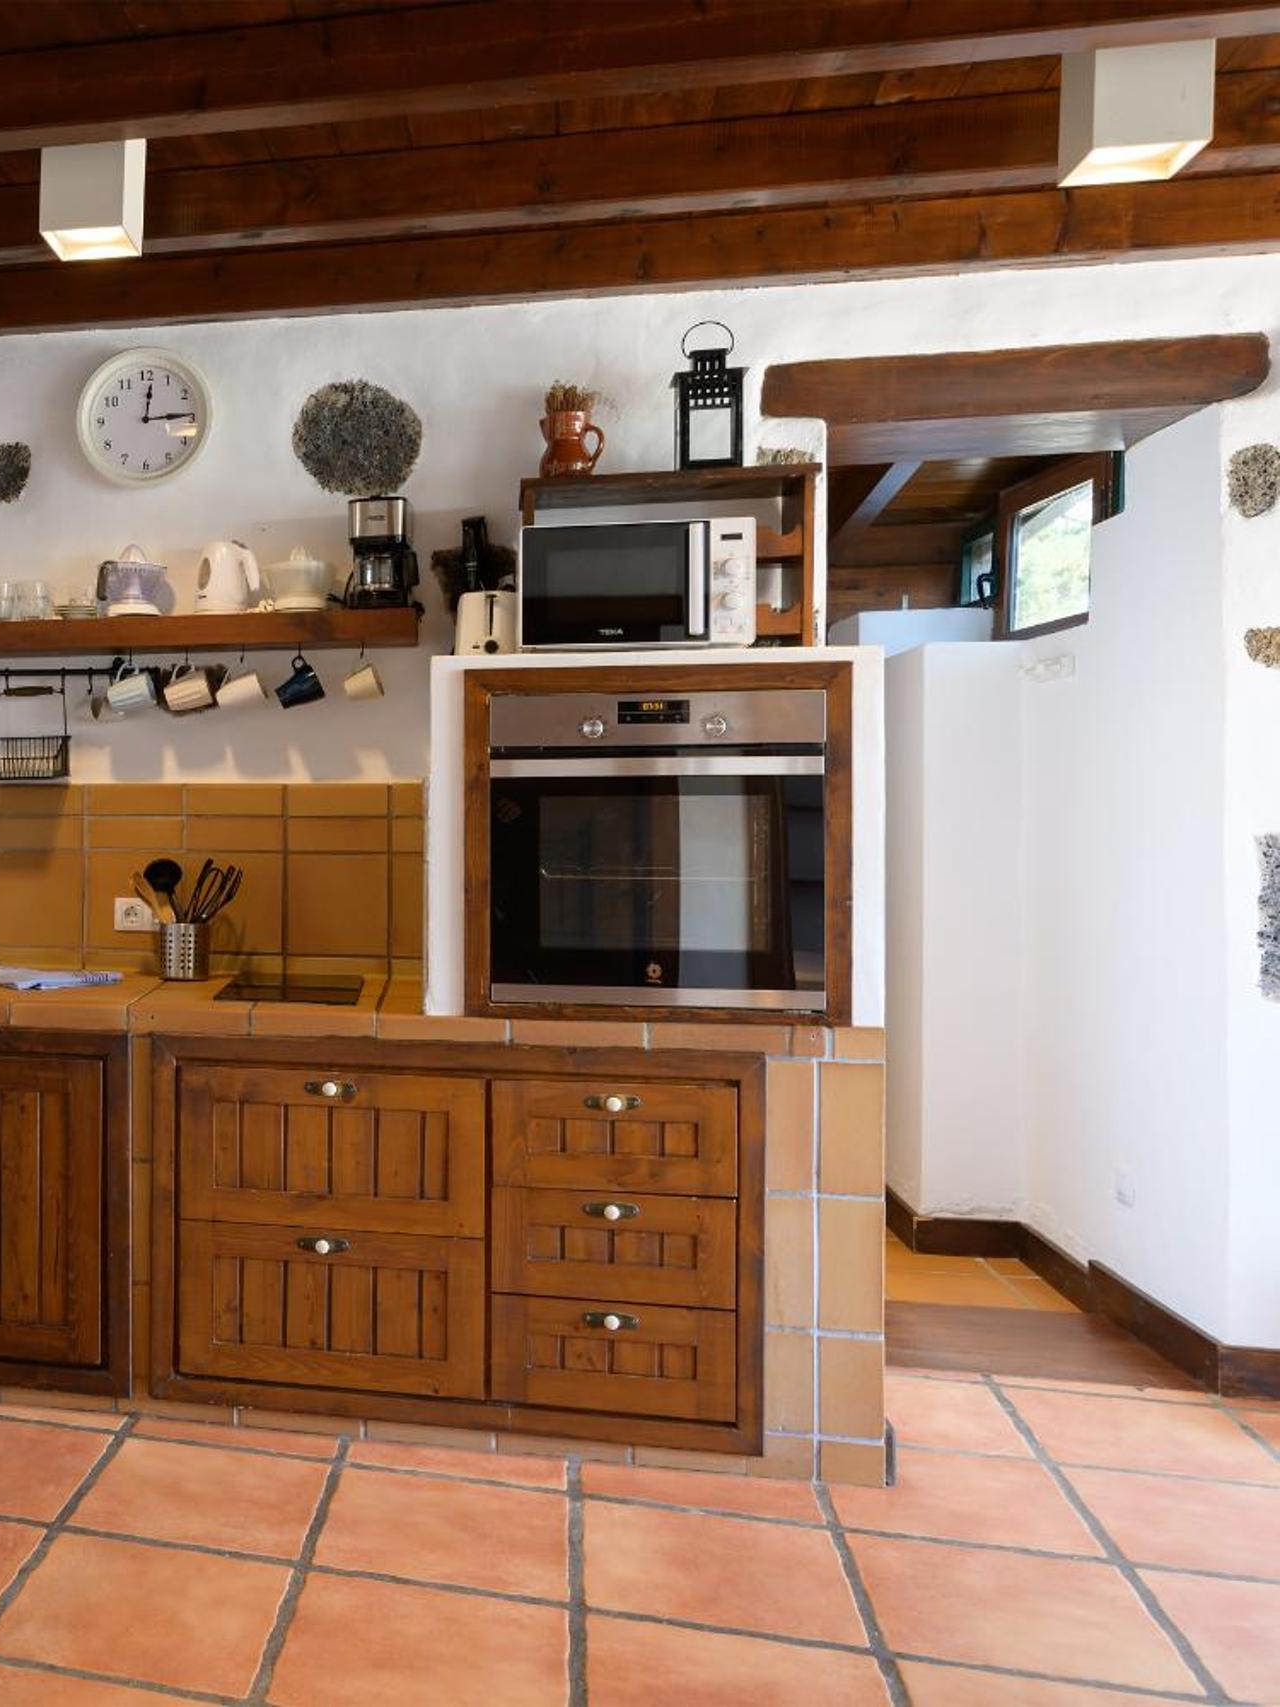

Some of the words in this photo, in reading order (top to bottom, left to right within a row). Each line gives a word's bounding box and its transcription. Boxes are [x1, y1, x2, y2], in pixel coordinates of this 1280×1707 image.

[140, 370, 154, 382] 12
[118, 378, 132, 390] 11
[104, 396, 119, 408] 10
